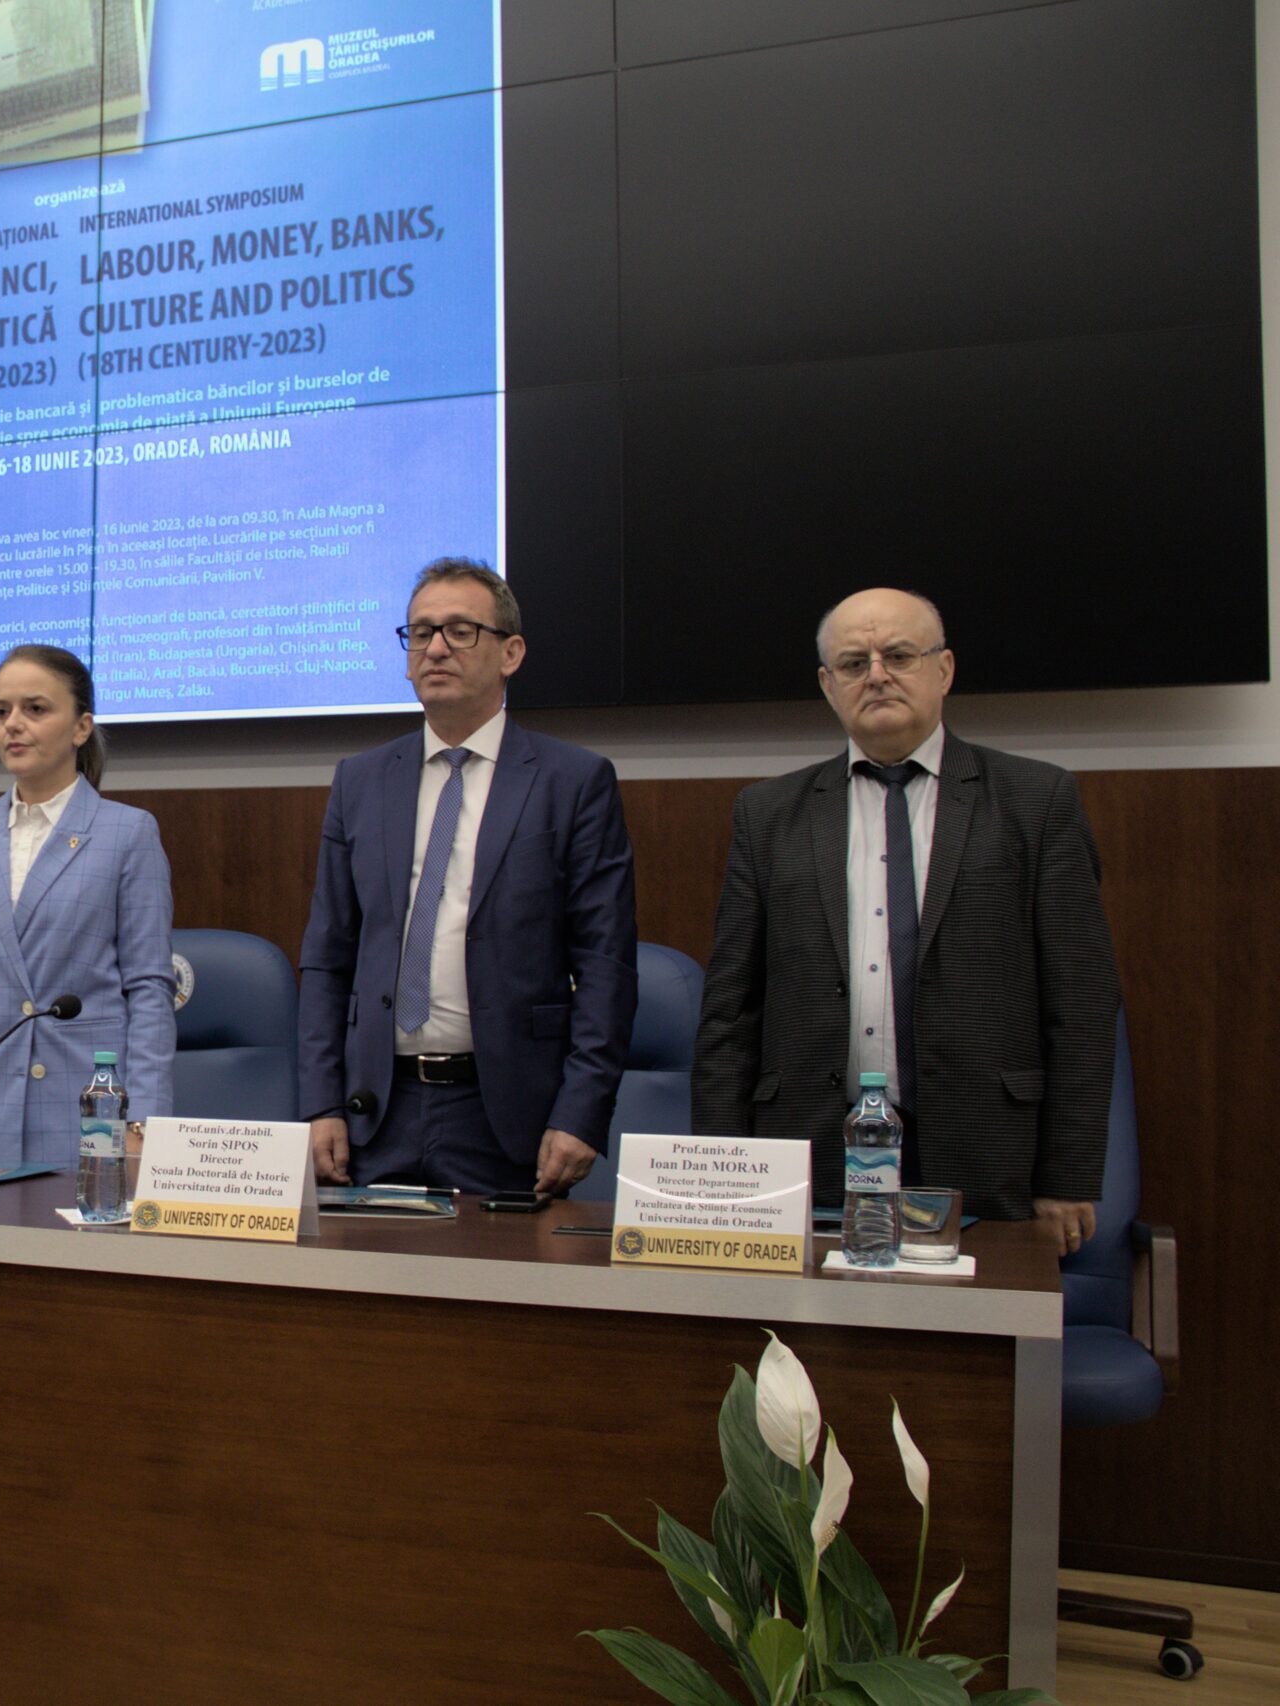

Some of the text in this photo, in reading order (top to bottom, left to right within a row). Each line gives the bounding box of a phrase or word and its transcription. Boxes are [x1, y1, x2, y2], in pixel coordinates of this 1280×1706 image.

[328, 28, 379, 46] MUZEUL
[328, 51, 380, 70] ORADEA
[33, 179, 125, 208] organizează
[79, 183, 304, 232] INTERNATIONAL SYMPOSIUM
[79, 205, 445, 284] LABOUR, MONEY, BANKS,
[78, 264, 414, 336] CULTURE AND POLITICS
[77, 322, 326, 381] (18TH CENTURY-2023)
[15, 401, 75, 421] bancară
[79, 399, 90, 419] și
[100, 389, 204, 417] problematica
[207, 381, 271, 400] băncilor
[277, 378, 290, 398] și
[293, 372, 364, 391] burselor
[367, 368, 390, 383] de
[16, 433, 47, 448] spre
[51, 421, 129, 441] economia
[132, 419, 153, 433] de
[199, 416, 208, 426] a
[212, 406, 270, 424] Uniunii
[275, 401, 356, 419] Europene
[35, 450, 79, 472] IUNIE
[82, 446, 129, 468] 2023,
[132, 438, 205, 462] ORADEA,
[209, 428, 292, 454] ROMÂNIA
[13, 533, 39, 543] avea
[41, 530, 59, 541] loc
[102, 524, 118, 536] 16
[119, 522, 148, 535] iunie
[151, 519, 184, 533] 2023,
[186, 517, 202, 529] de
[205, 516, 216, 528] la
[218, 517, 239, 527] ora
[242, 511, 279, 525] 09.30,
[296, 507, 326, 520] Aula
[328, 506, 374, 519] Magna
[376, 505, 385, 514] a
[16, 583, 58, 596] Politice
[202, 570, 252, 583] Pavilion
[253, 568, 264, 580] V.
[169, 612, 185, 623] de
[230, 605, 298, 620] cercetători
[358, 601, 380, 612] din
[179, 1124, 273, 1136] Prof.univ.dr.habil.
[188, 1139, 217, 1149] Sorin
[673, 1143, 748, 1156] Prof.univ.dr.
[200, 1154, 243, 1164] Director
[650, 1159, 769, 1174] Ioan Dan MORAR
[151, 1166, 290, 1182] Școala Doctorală de Istorie
[657, 1176, 759, 1188] Director Departament
[848, 1174, 883, 1185] DORNA
[153, 1180, 283, 1196] Universitatea din Oradea
[635, 1200, 681, 1210] Facultatea
[685, 1202, 695, 1210] de
[732, 1204, 782, 1215] Economice
[164, 1210, 294, 1231] UNIVERSITY OF ORADEA
[639, 1213, 772, 1229] Universitatea din Oradea
[647, 1238, 797, 1261] UNIVERSITY OF ORADEA
